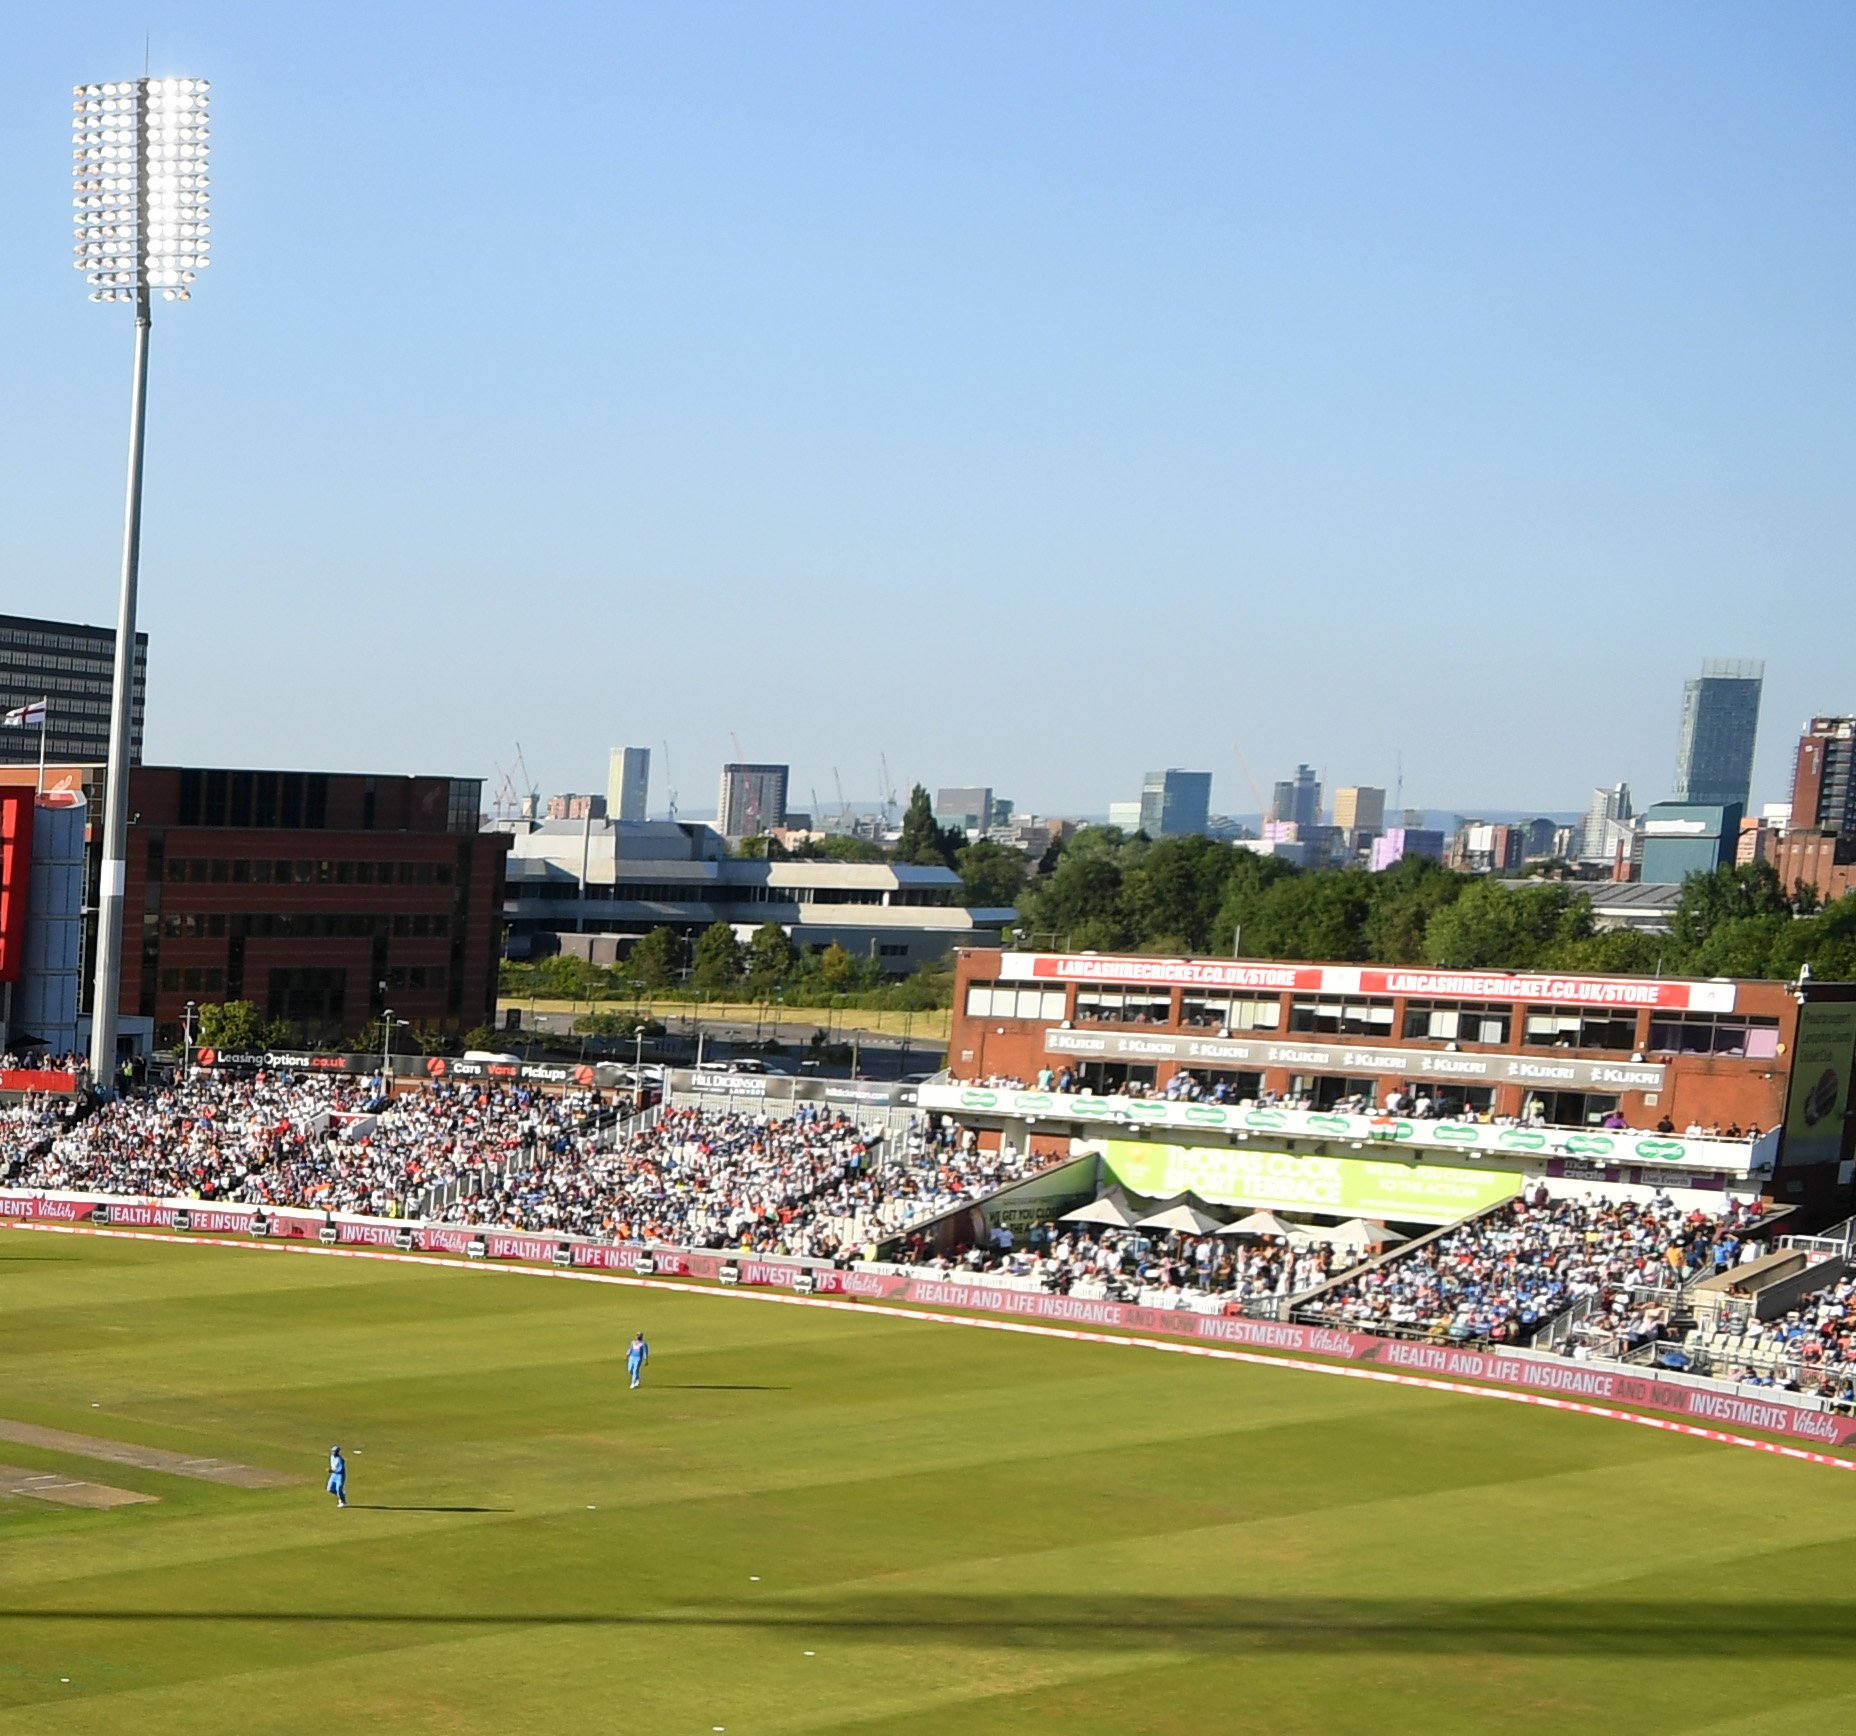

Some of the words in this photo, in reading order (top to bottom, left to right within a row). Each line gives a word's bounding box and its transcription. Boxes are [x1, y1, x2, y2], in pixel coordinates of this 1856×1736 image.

[1057, 960, 1295, 986] LANCASHIRECRICKET.CO.UK/STORE
[1387, 974, 1659, 1003] LANCASHIRECRICKET.CO.UK/STORE
[454, 1063, 481, 1074] Cars
[488, 1064, 517, 1076] Vans
[521, 1067, 567, 1080] Pickups
[1268, 1152, 1340, 1178] COOK
[38, 1201, 76, 1220] Vitality
[189, 1213, 207, 1229] IFE
[430, 1229, 467, 1252] Vitality
[494, 1241, 539, 1259] HEALTH
[842, 1272, 884, 1297] Vitality
[916, 1283, 967, 1305] HEALTH
[972, 1288, 1002, 1310] AND
[1007, 1293, 1034, 1313] LIFE
[1038, 1296, 1120, 1324] INSURANCE
[1200, 1319, 1303, 1346] INVESTMENTS
[1309, 1329, 1355, 1358] Vitality
[1388, 1344, 1446, 1368] HEALTH
[1451, 1354, 1482, 1374] AND
[1488, 1360, 1518, 1381] LIFE
[1524, 1365, 1612, 1396] INSURANCE
[1690, 1393, 1786, 1429] INVESTMENTS
[1792, 1408, 1838, 1440] Vitality
